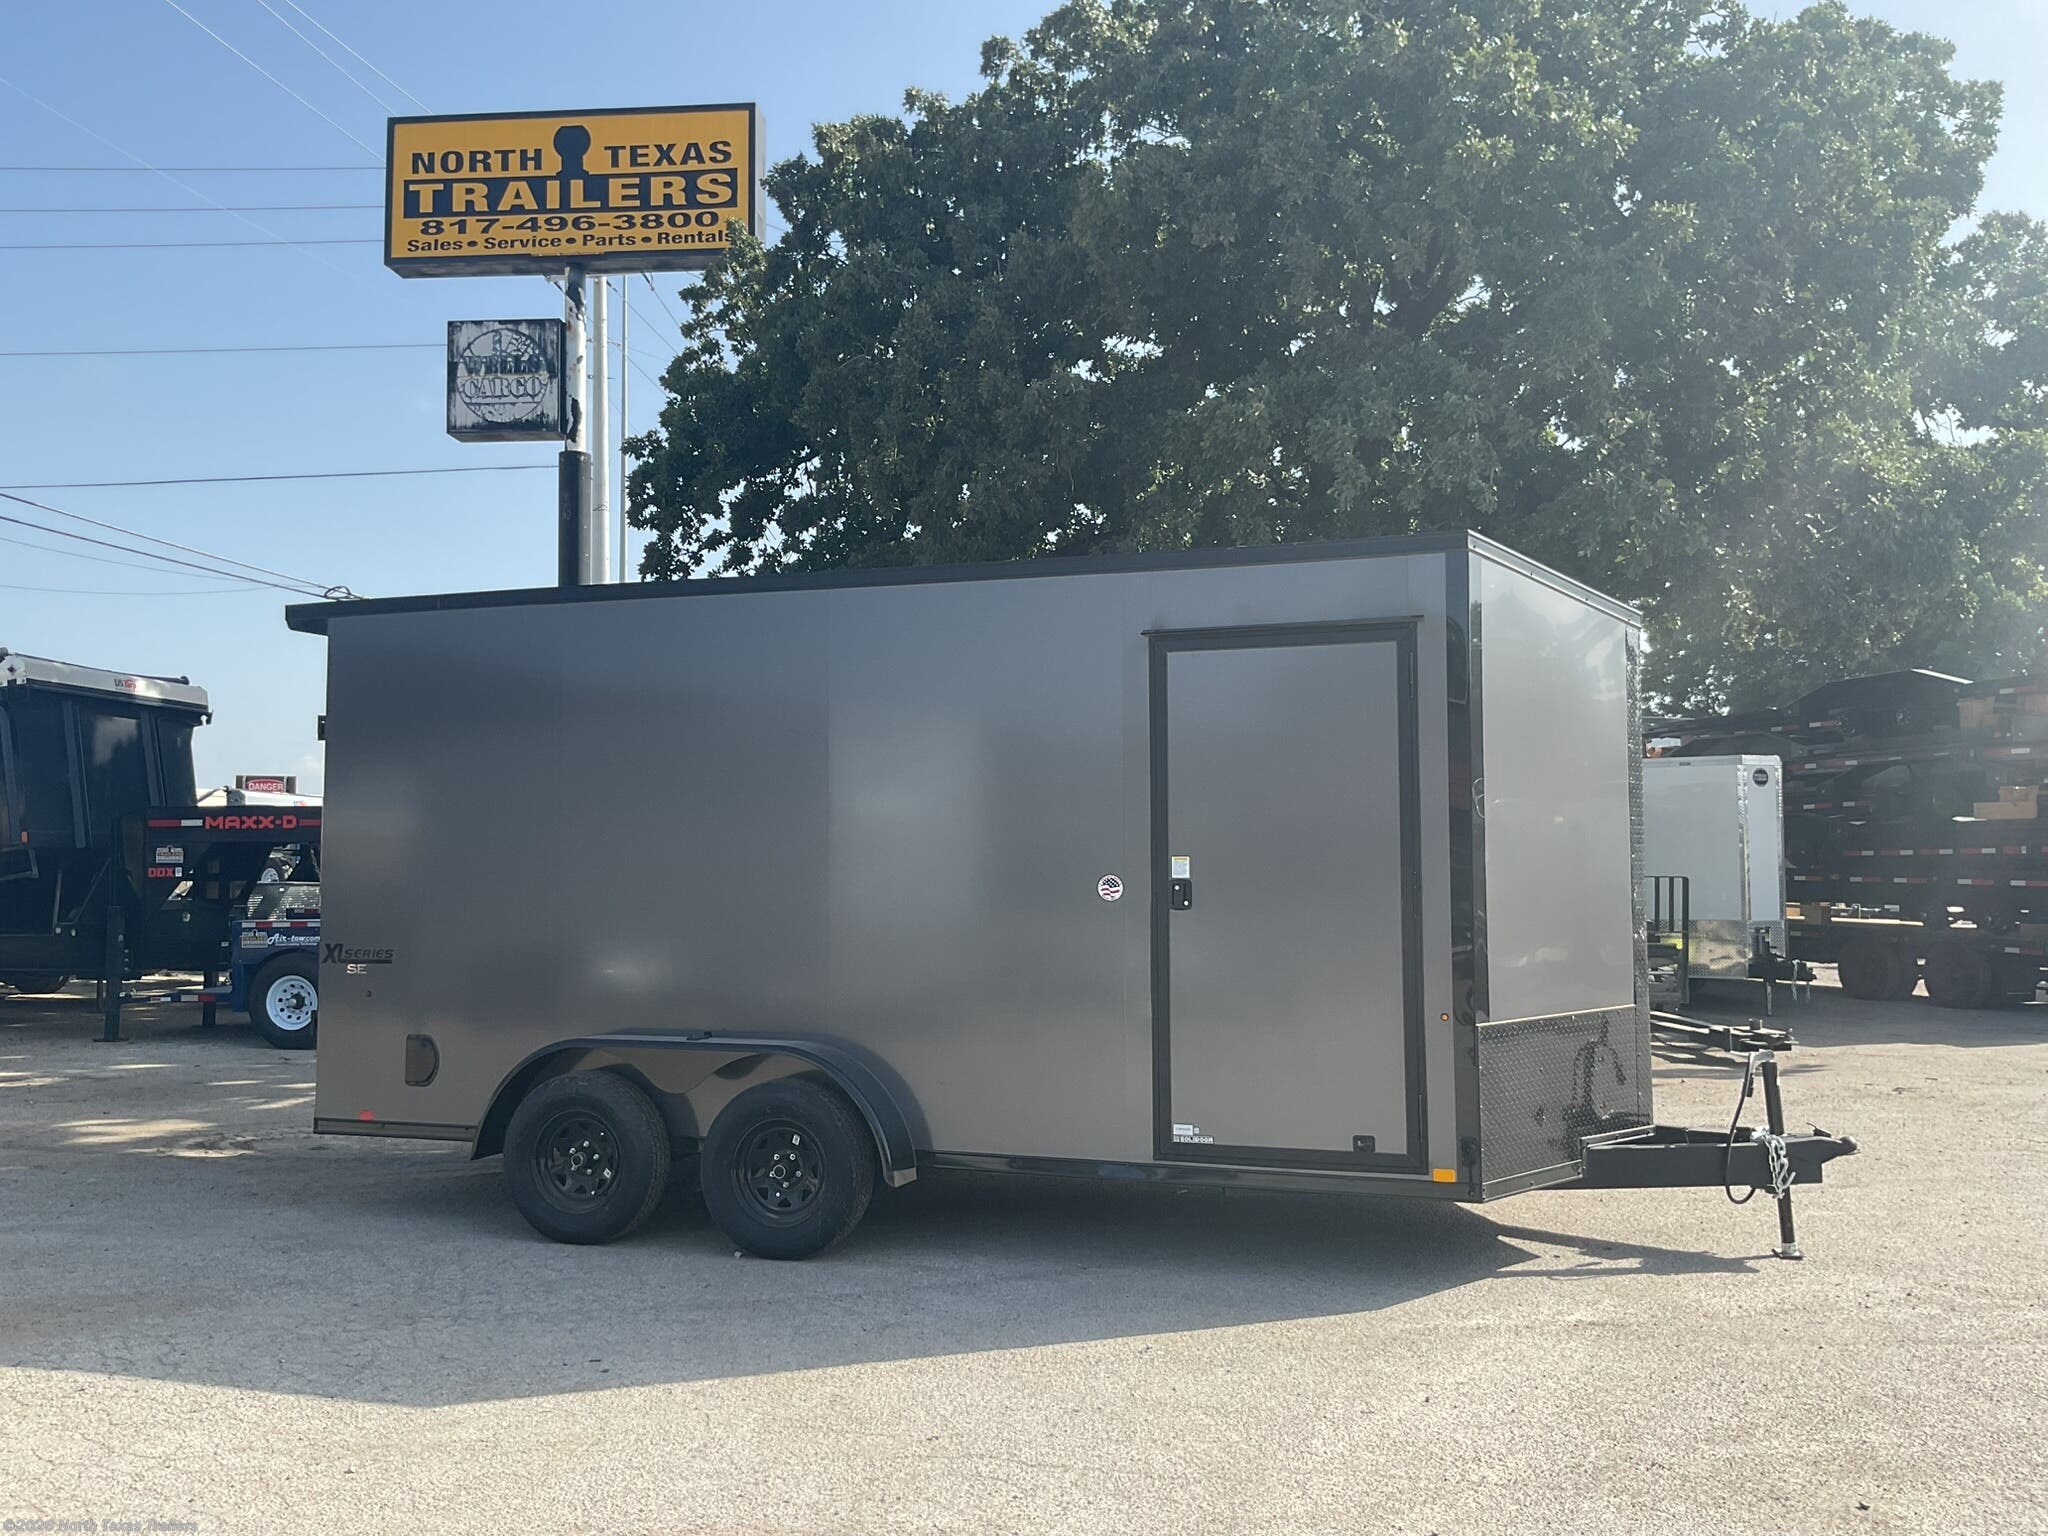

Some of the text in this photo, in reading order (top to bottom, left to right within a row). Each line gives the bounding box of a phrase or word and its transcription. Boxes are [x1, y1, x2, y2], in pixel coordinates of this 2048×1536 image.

[411, 140, 732, 175] NORTH TEXAS
[408, 172, 734, 214] TRAILERS
[420, 211, 719, 236] 817-496-3800
[407, 229, 736, 252] Sales Service Parts Rentals
[463, 376, 543, 400] CARGO
[248, 783, 284, 791] DANGER
[205, 815, 298, 830] MAXX-D
[346, 963, 367, 974] SE
